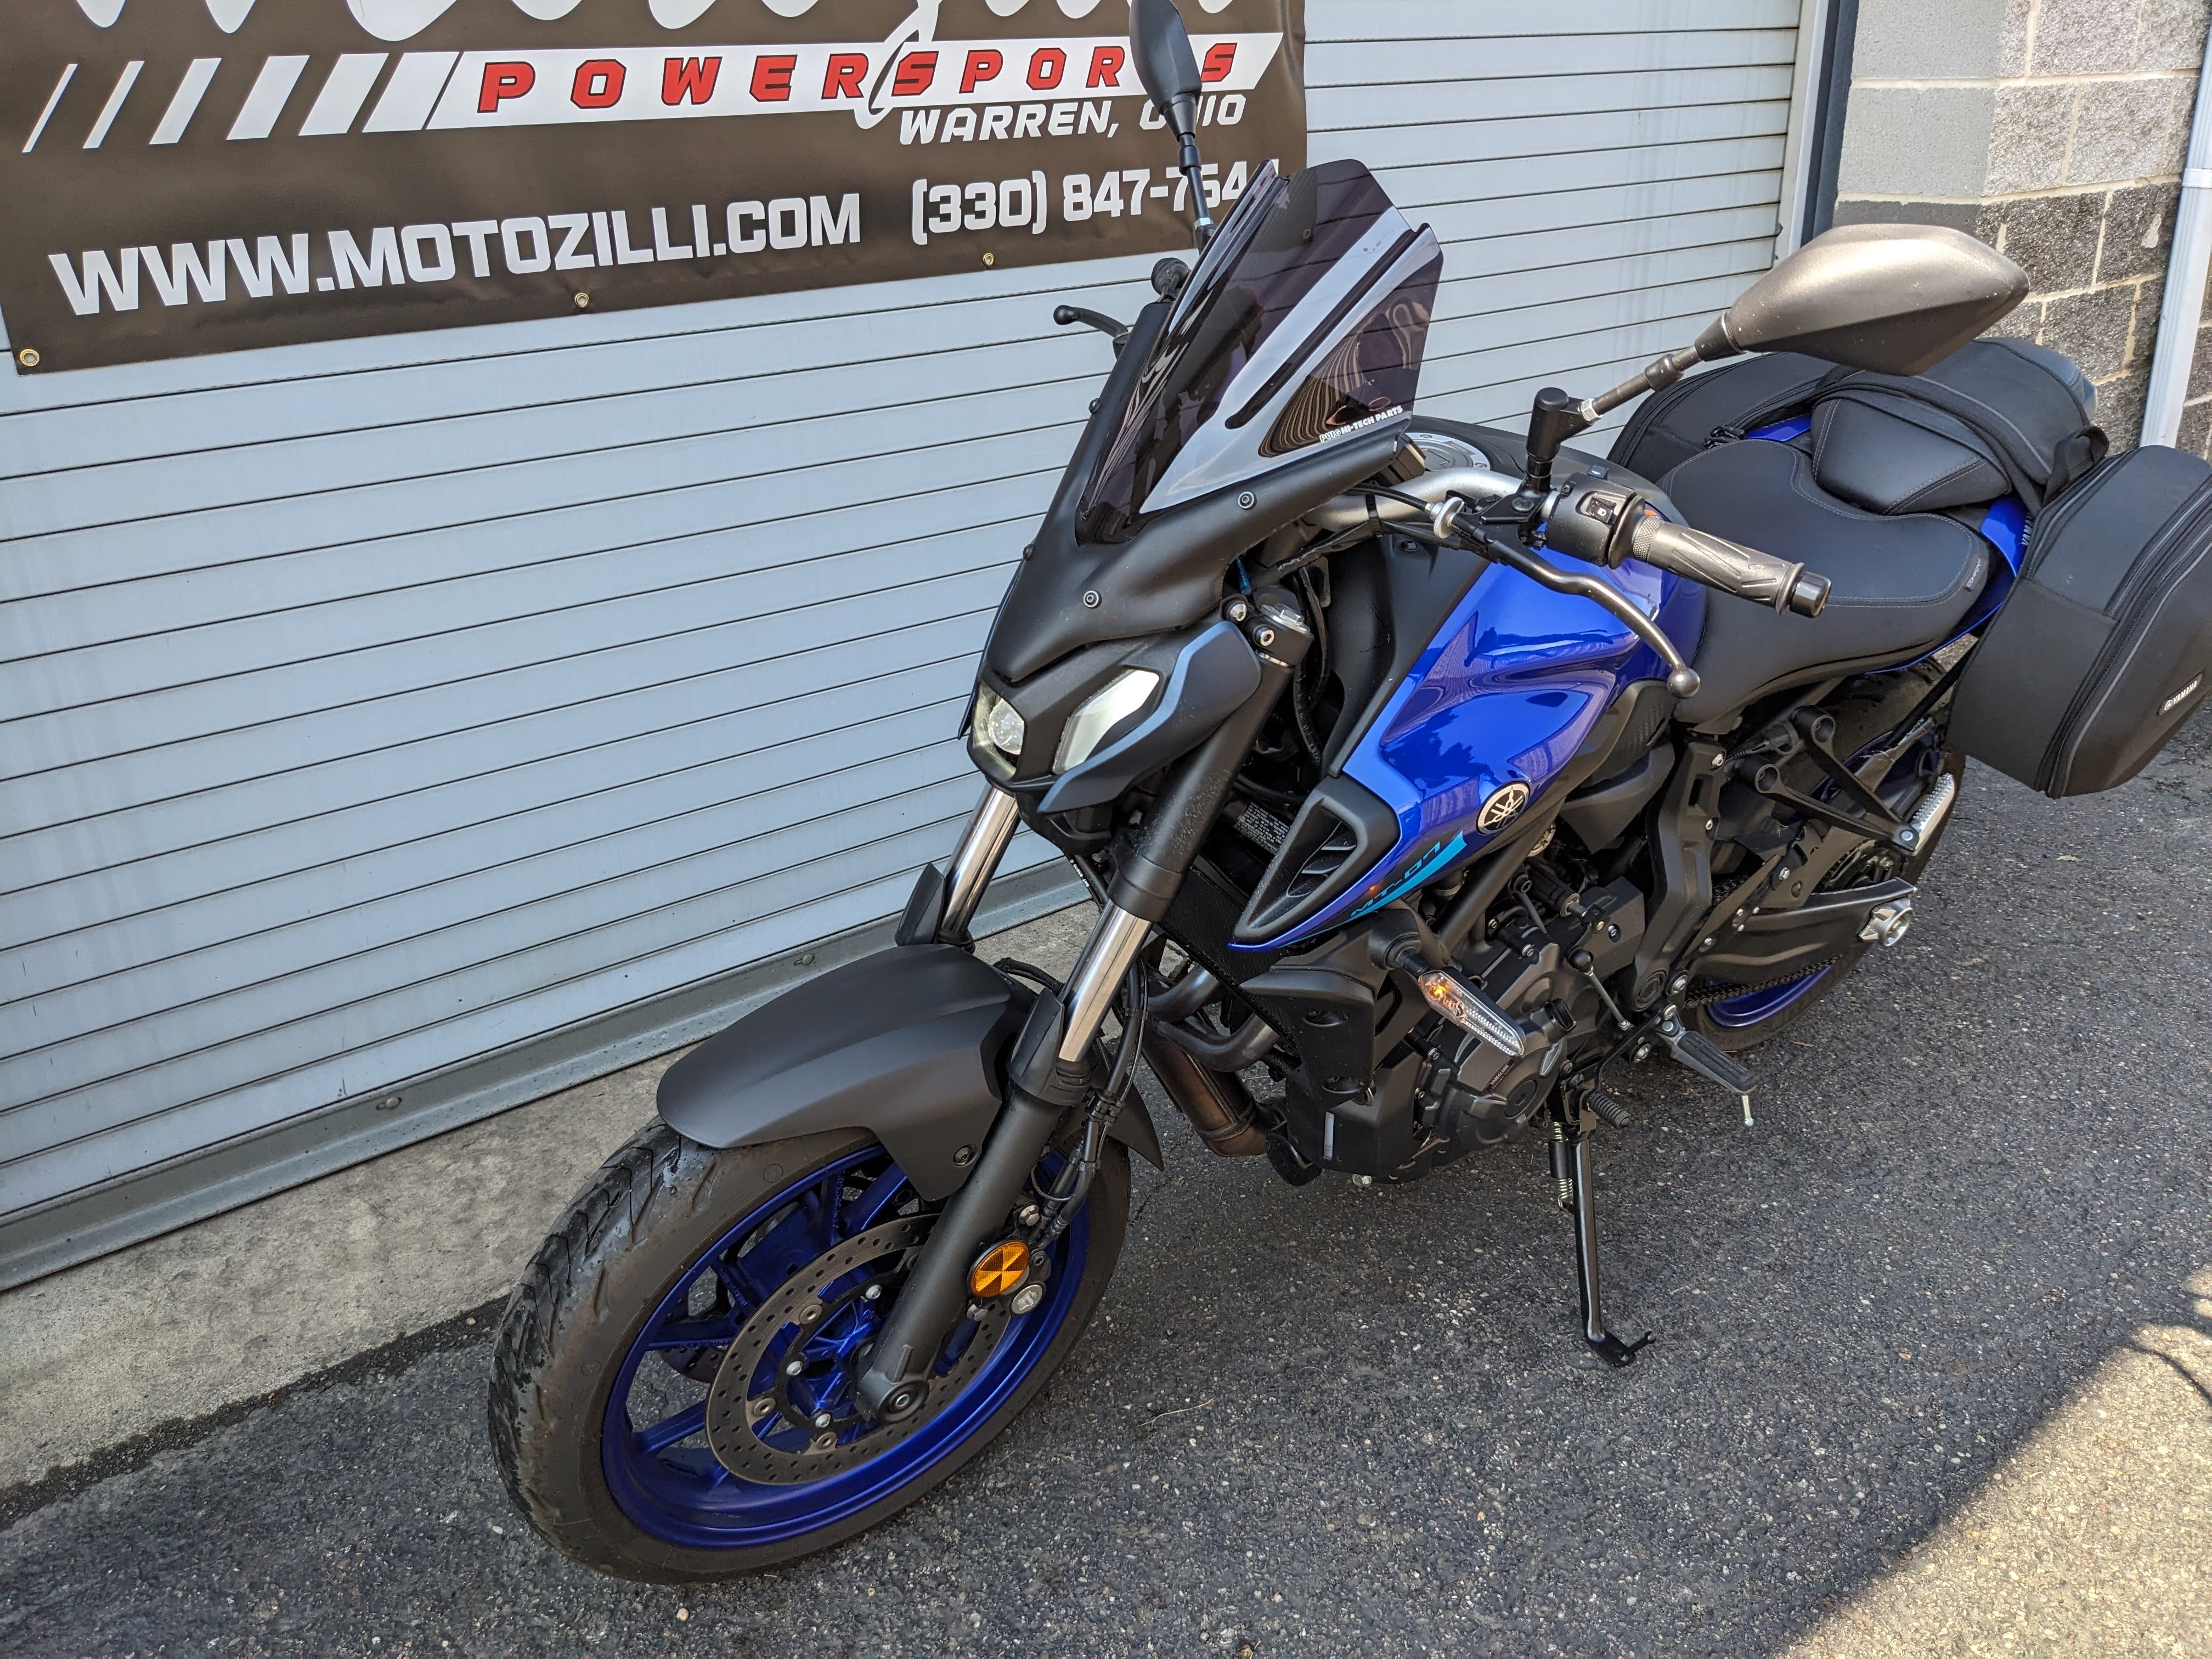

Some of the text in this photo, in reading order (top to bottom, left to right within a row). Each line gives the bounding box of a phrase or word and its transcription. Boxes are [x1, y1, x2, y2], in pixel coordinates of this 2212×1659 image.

[477, 42, 1238, 114] POWERSPORS
[899, 101, 1119, 146] WARREN,
[48, 159, 1279, 316] WWW.MOTOZILLI.COM (330) 847-754
[1319, 405, 1403, 443] PUIG HI-TECH PARTS
[2173, 680, 2197, 705] YAMAHA
[1350, 841, 1441, 917] MT-07
